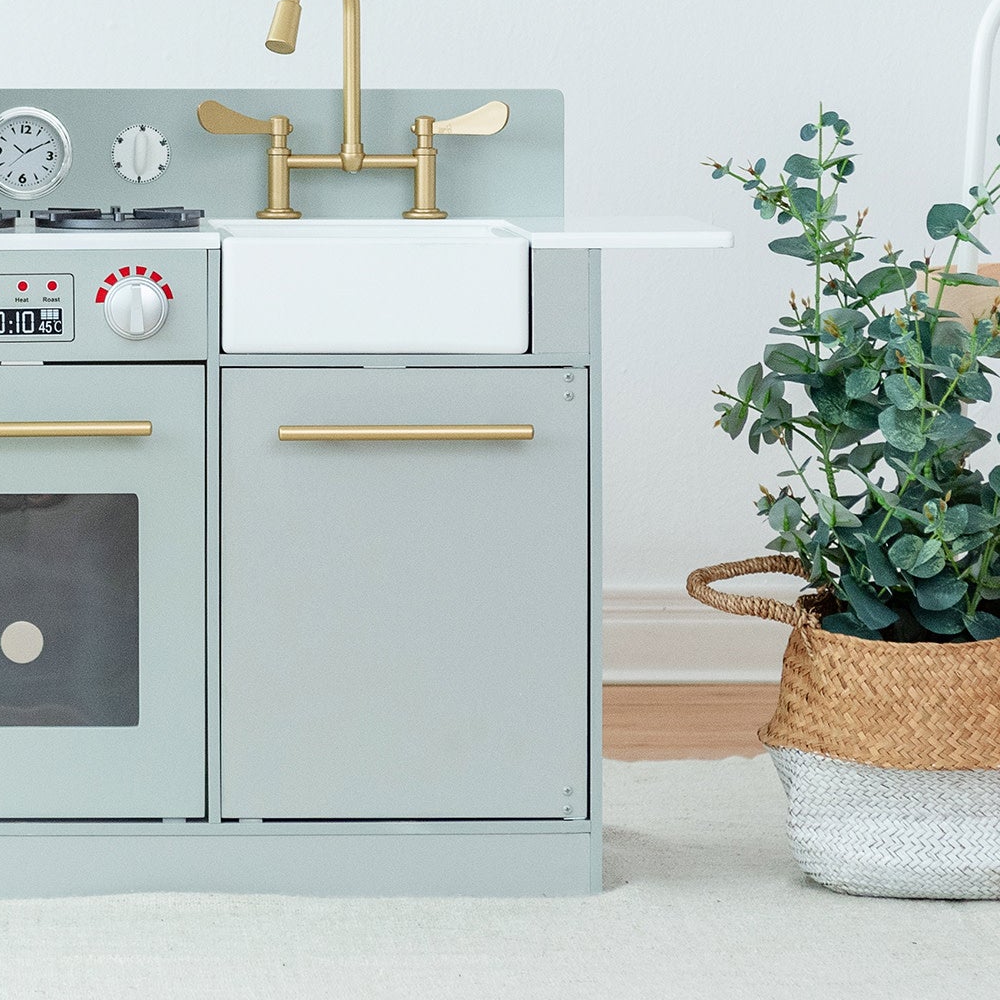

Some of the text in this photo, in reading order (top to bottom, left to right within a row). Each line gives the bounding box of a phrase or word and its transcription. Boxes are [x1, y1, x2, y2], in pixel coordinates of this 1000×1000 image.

[20, 124, 32, 135] 12
[46, 151, 54, 161] 3
[18, 173, 27, 184] 6
